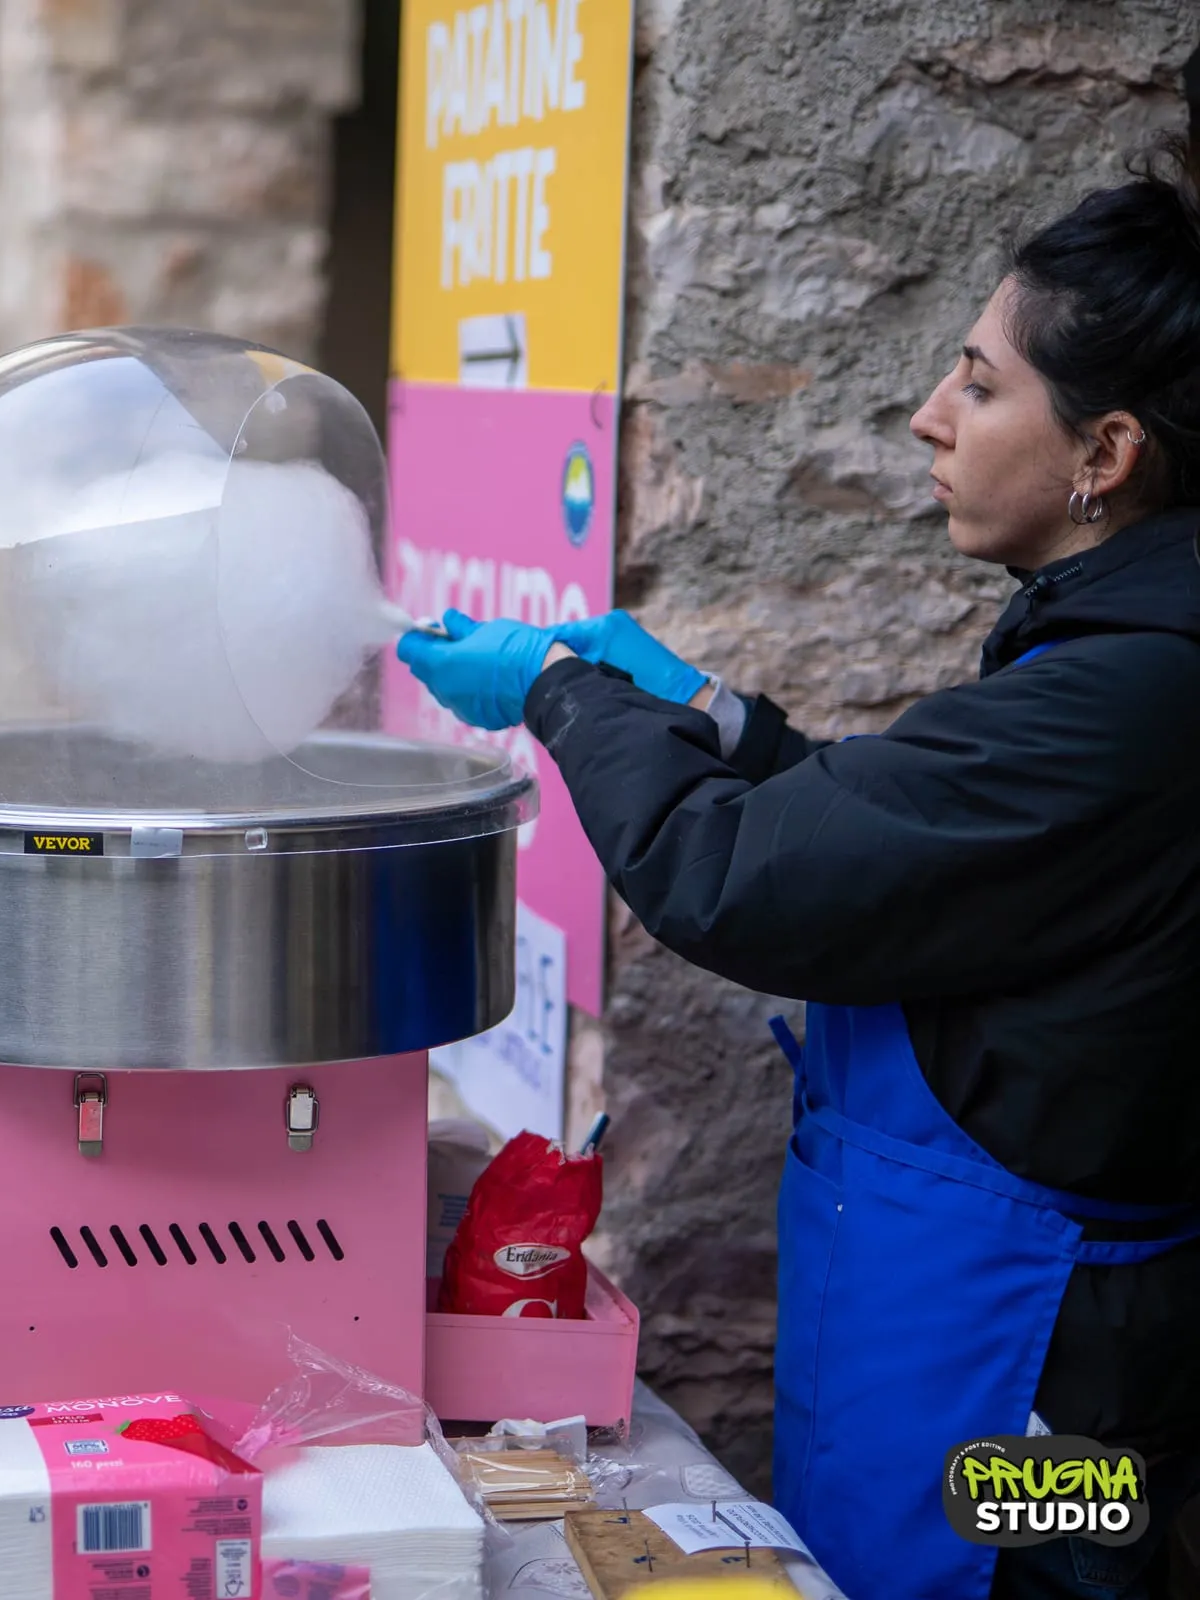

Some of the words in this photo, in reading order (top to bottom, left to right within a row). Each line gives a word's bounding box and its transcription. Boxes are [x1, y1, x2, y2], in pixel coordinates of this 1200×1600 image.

[426, 0, 585, 150] PATATINE
[440, 147, 556, 291] FRITTE
[33, 836, 90, 850] VEVOR
[506, 1247, 558, 1263] Eridania
[46, 1394, 182, 1413] MONOVE
[71, 1460, 92, 1469] 160
